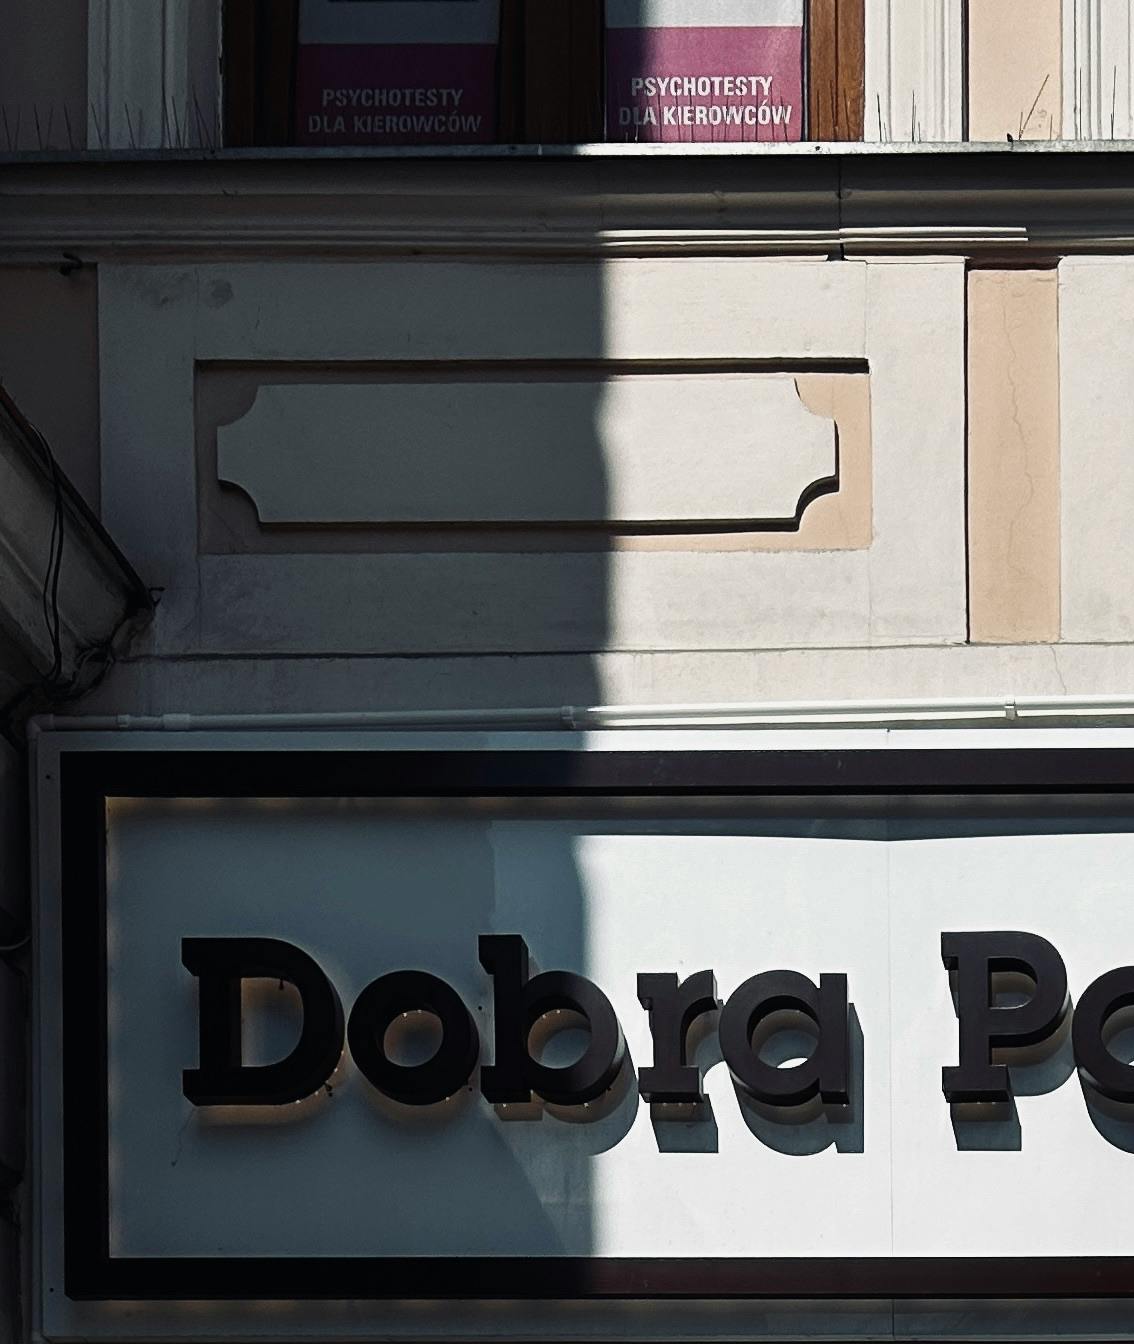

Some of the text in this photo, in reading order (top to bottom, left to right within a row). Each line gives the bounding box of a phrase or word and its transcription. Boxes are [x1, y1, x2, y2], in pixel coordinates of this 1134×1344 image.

[322, 88, 463, 107] PSYCHOTESTY
[631, 76, 773, 97] PSYCHOTESTY
[308, 110, 482, 133] DLA KIEROWCÓW
[618, 98, 792, 126] DLA KIEROWCÓW
[181, 933, 849, 1106] Dobra
